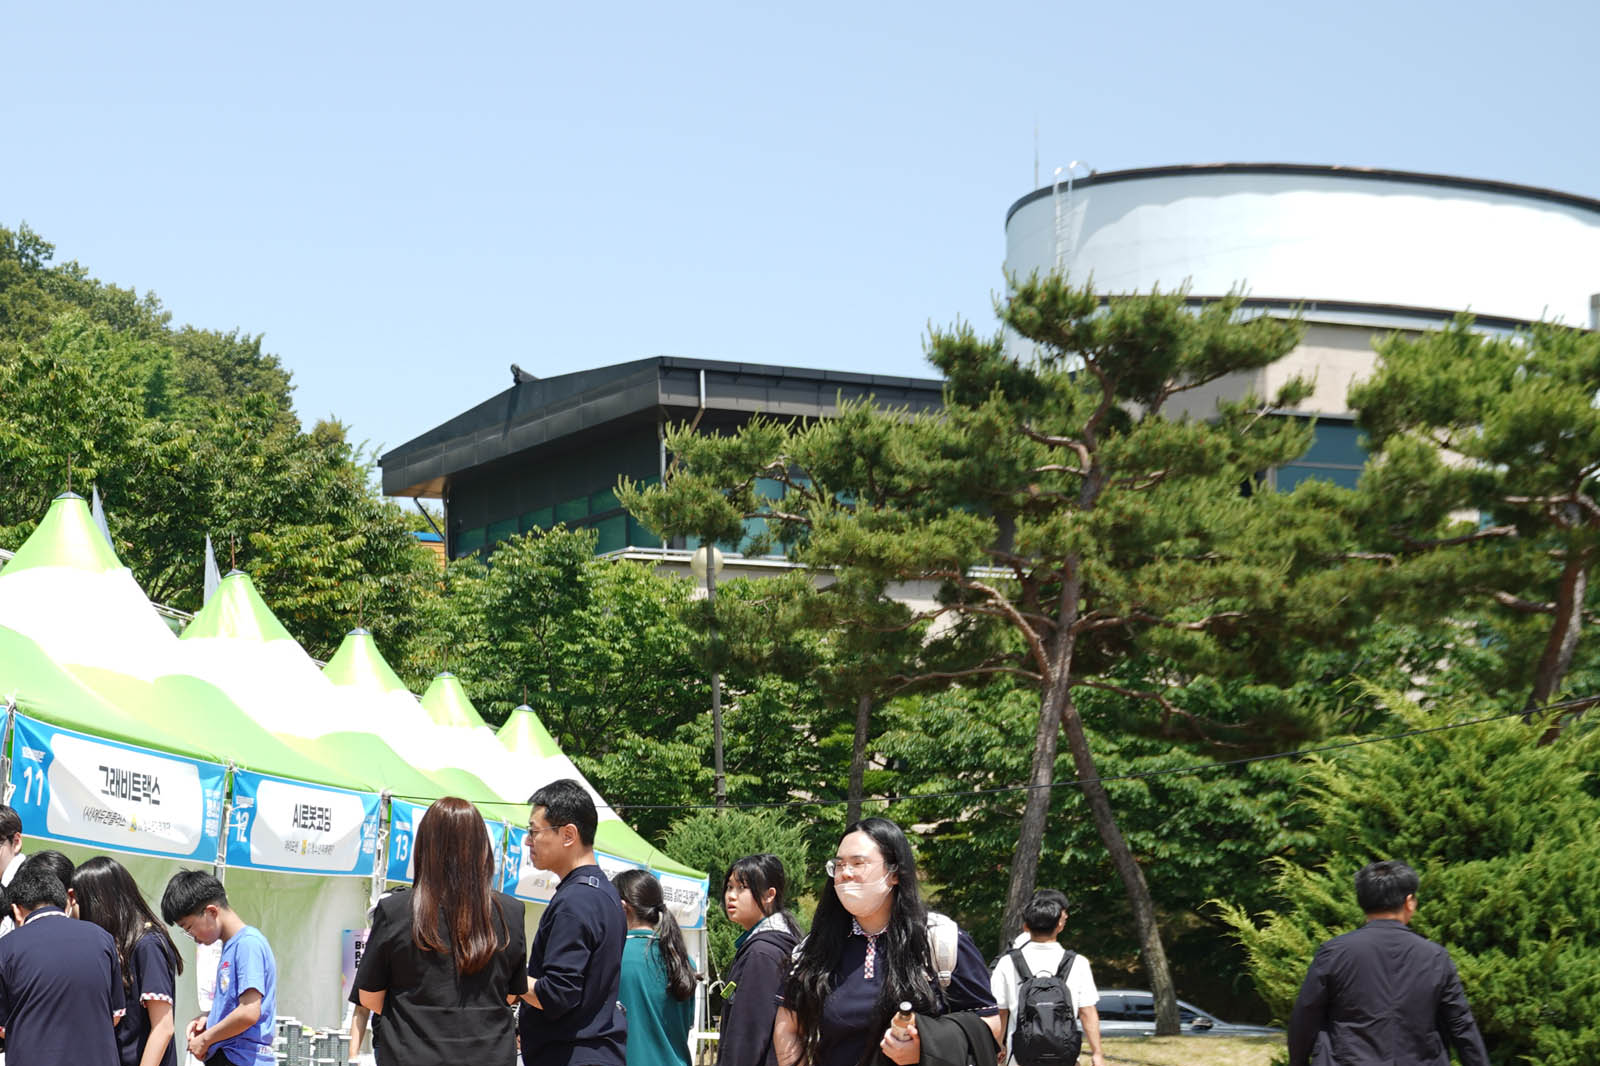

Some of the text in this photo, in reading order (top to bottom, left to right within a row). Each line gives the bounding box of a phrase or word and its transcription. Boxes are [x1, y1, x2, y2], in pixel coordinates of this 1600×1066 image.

[23, 766, 44, 806] 11
[99, 765, 161, 806] 그래비트랙스
[292, 803, 332, 833] AI로봇코딩
[395, 834, 409, 861] 13
